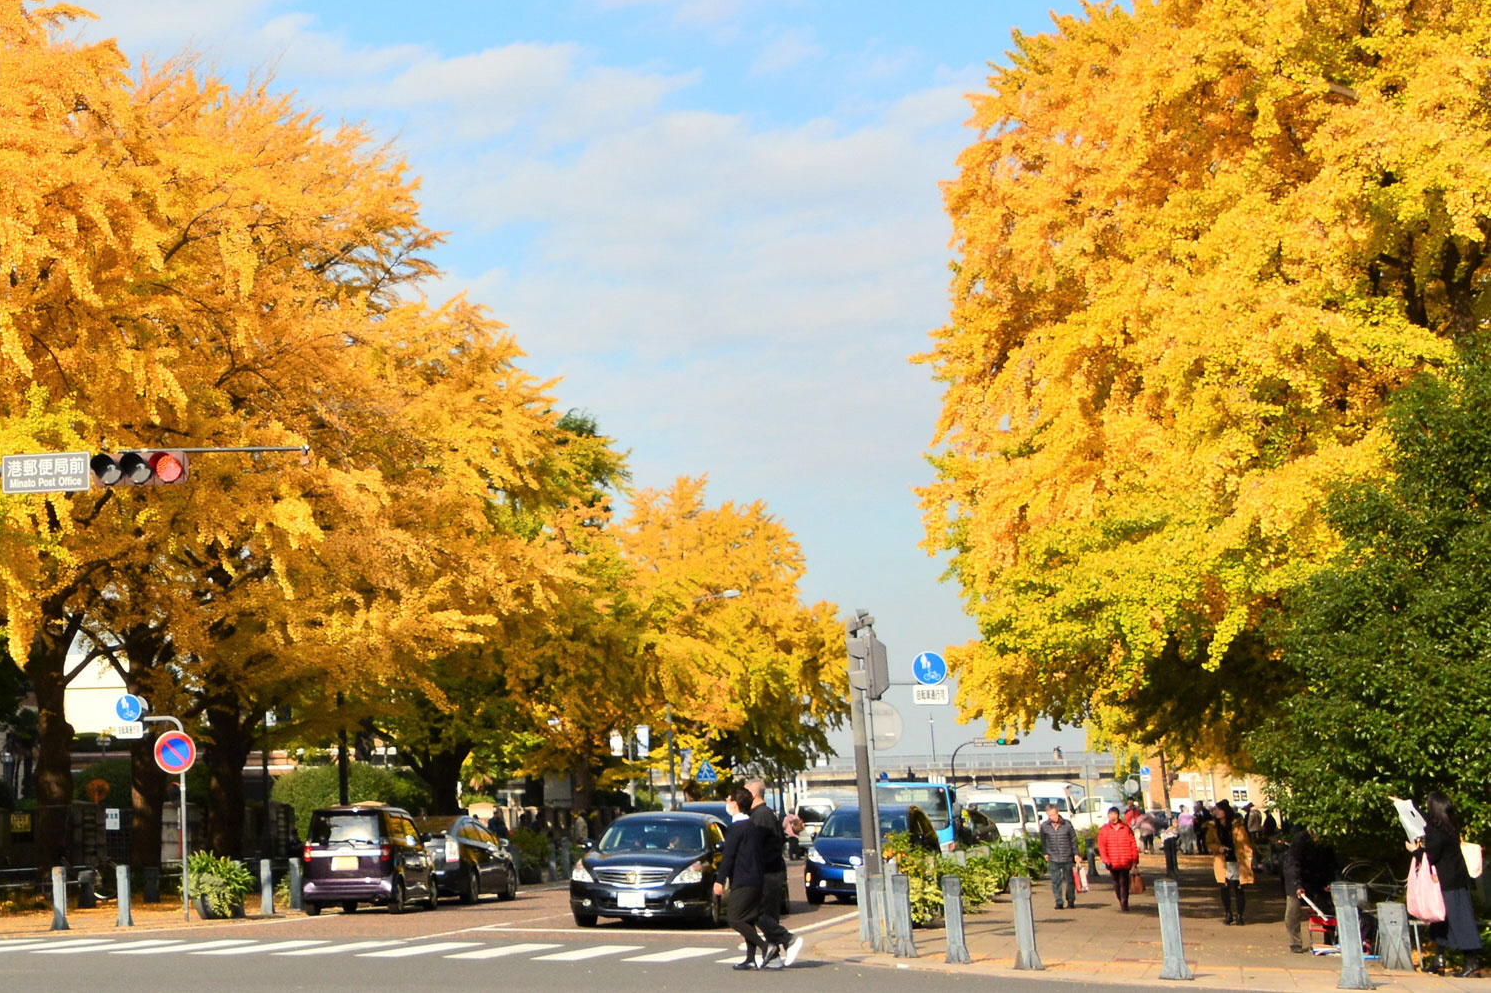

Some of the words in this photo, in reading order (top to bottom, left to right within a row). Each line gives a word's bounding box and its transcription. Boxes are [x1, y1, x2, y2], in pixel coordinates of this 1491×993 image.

[7, 456, 84, 477] 港郵便局前
[9, 478, 36, 488] Minato
[38, 477, 56, 487] Post
[58, 476, 82, 486] Office
